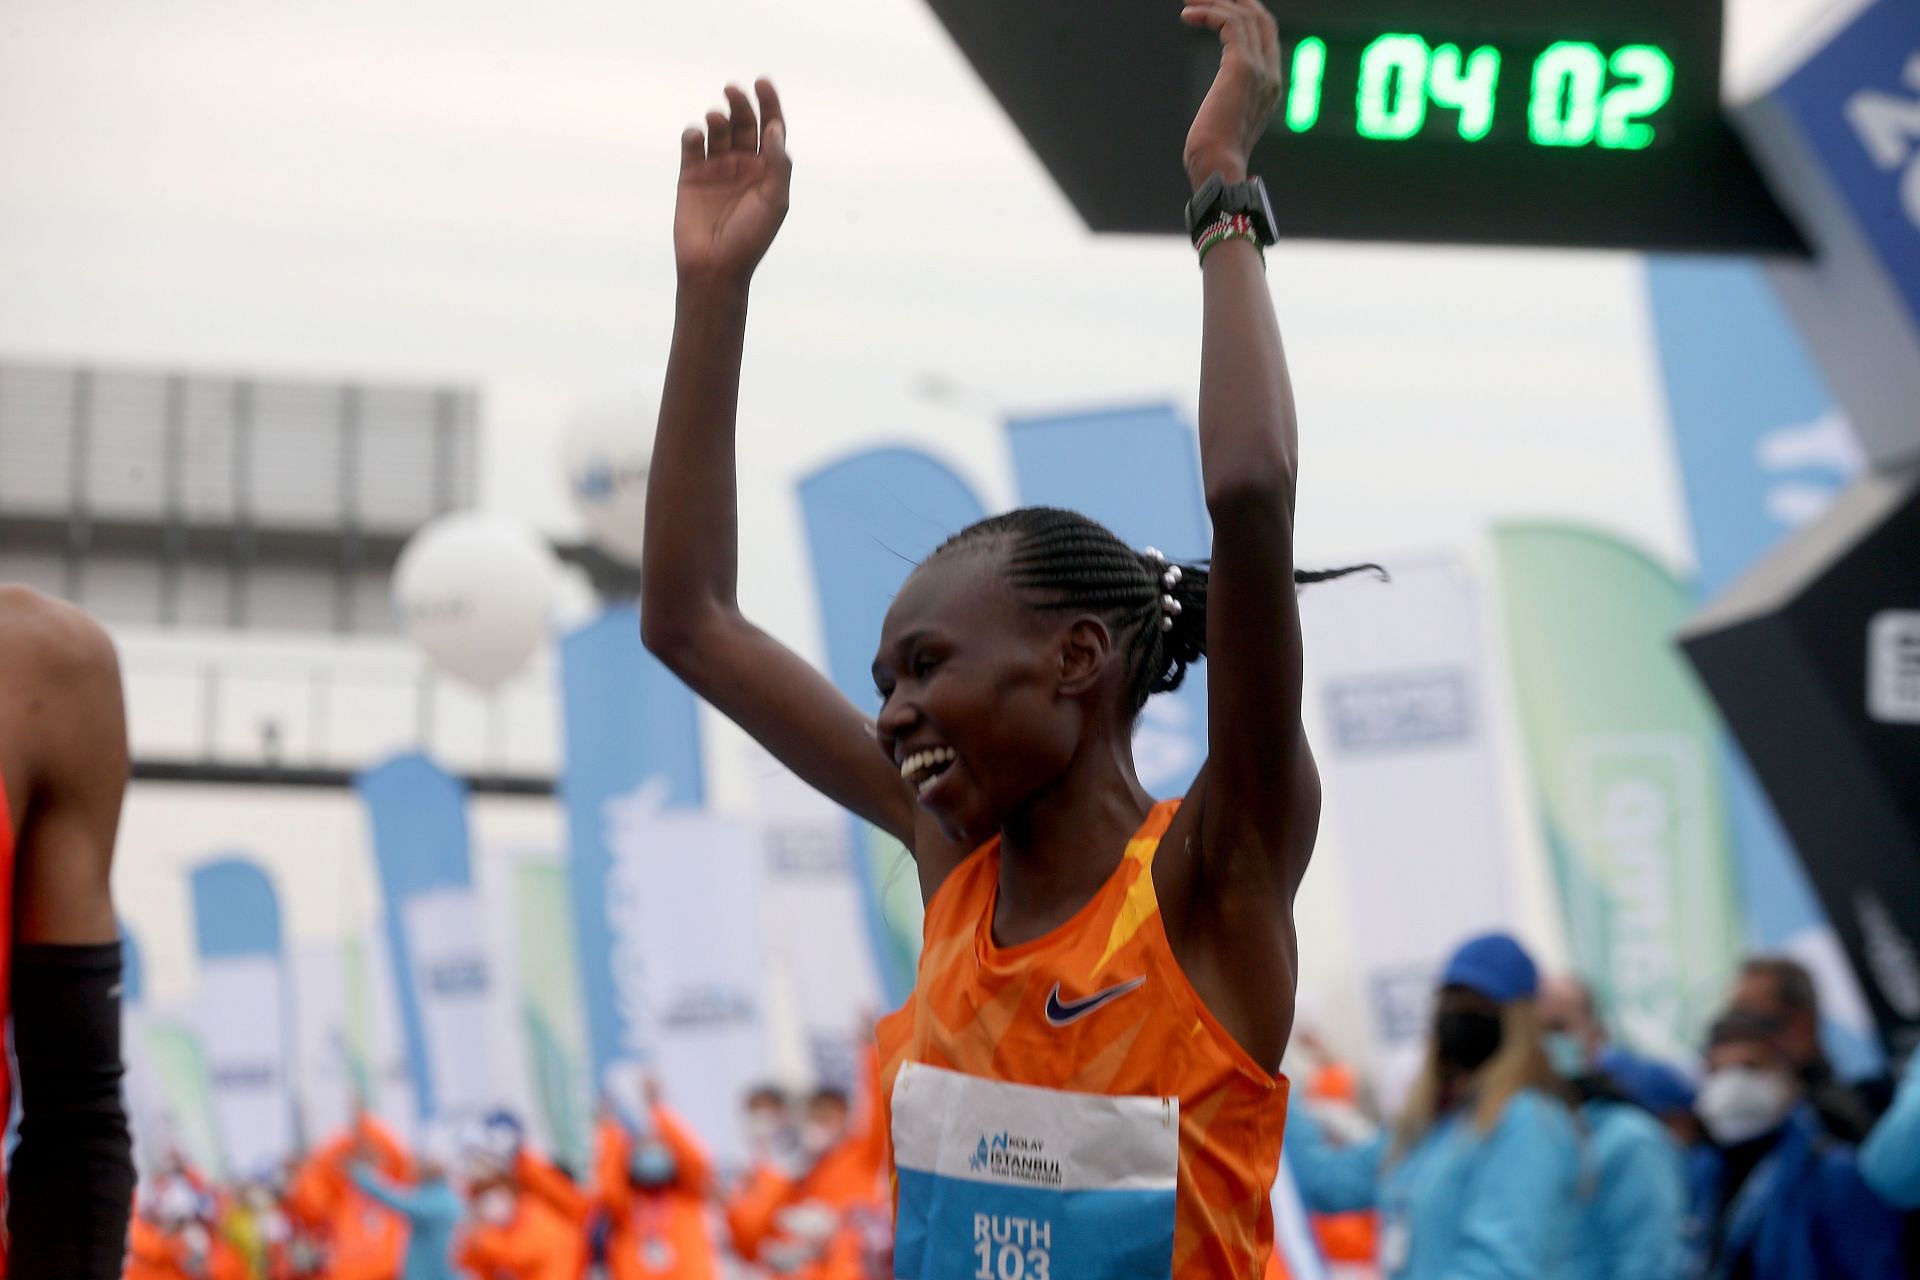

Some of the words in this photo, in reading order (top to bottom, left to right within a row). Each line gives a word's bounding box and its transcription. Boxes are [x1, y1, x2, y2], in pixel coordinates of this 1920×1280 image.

[1285, 36, 1326, 132] 1
[1356, 33, 1501, 141] 04
[1528, 40, 1674, 149] 02
[1009, 1136, 1043, 1152] KOLAY
[974, 1214, 1050, 1249] RUTH
[975, 1241, 1050, 1280] 103
